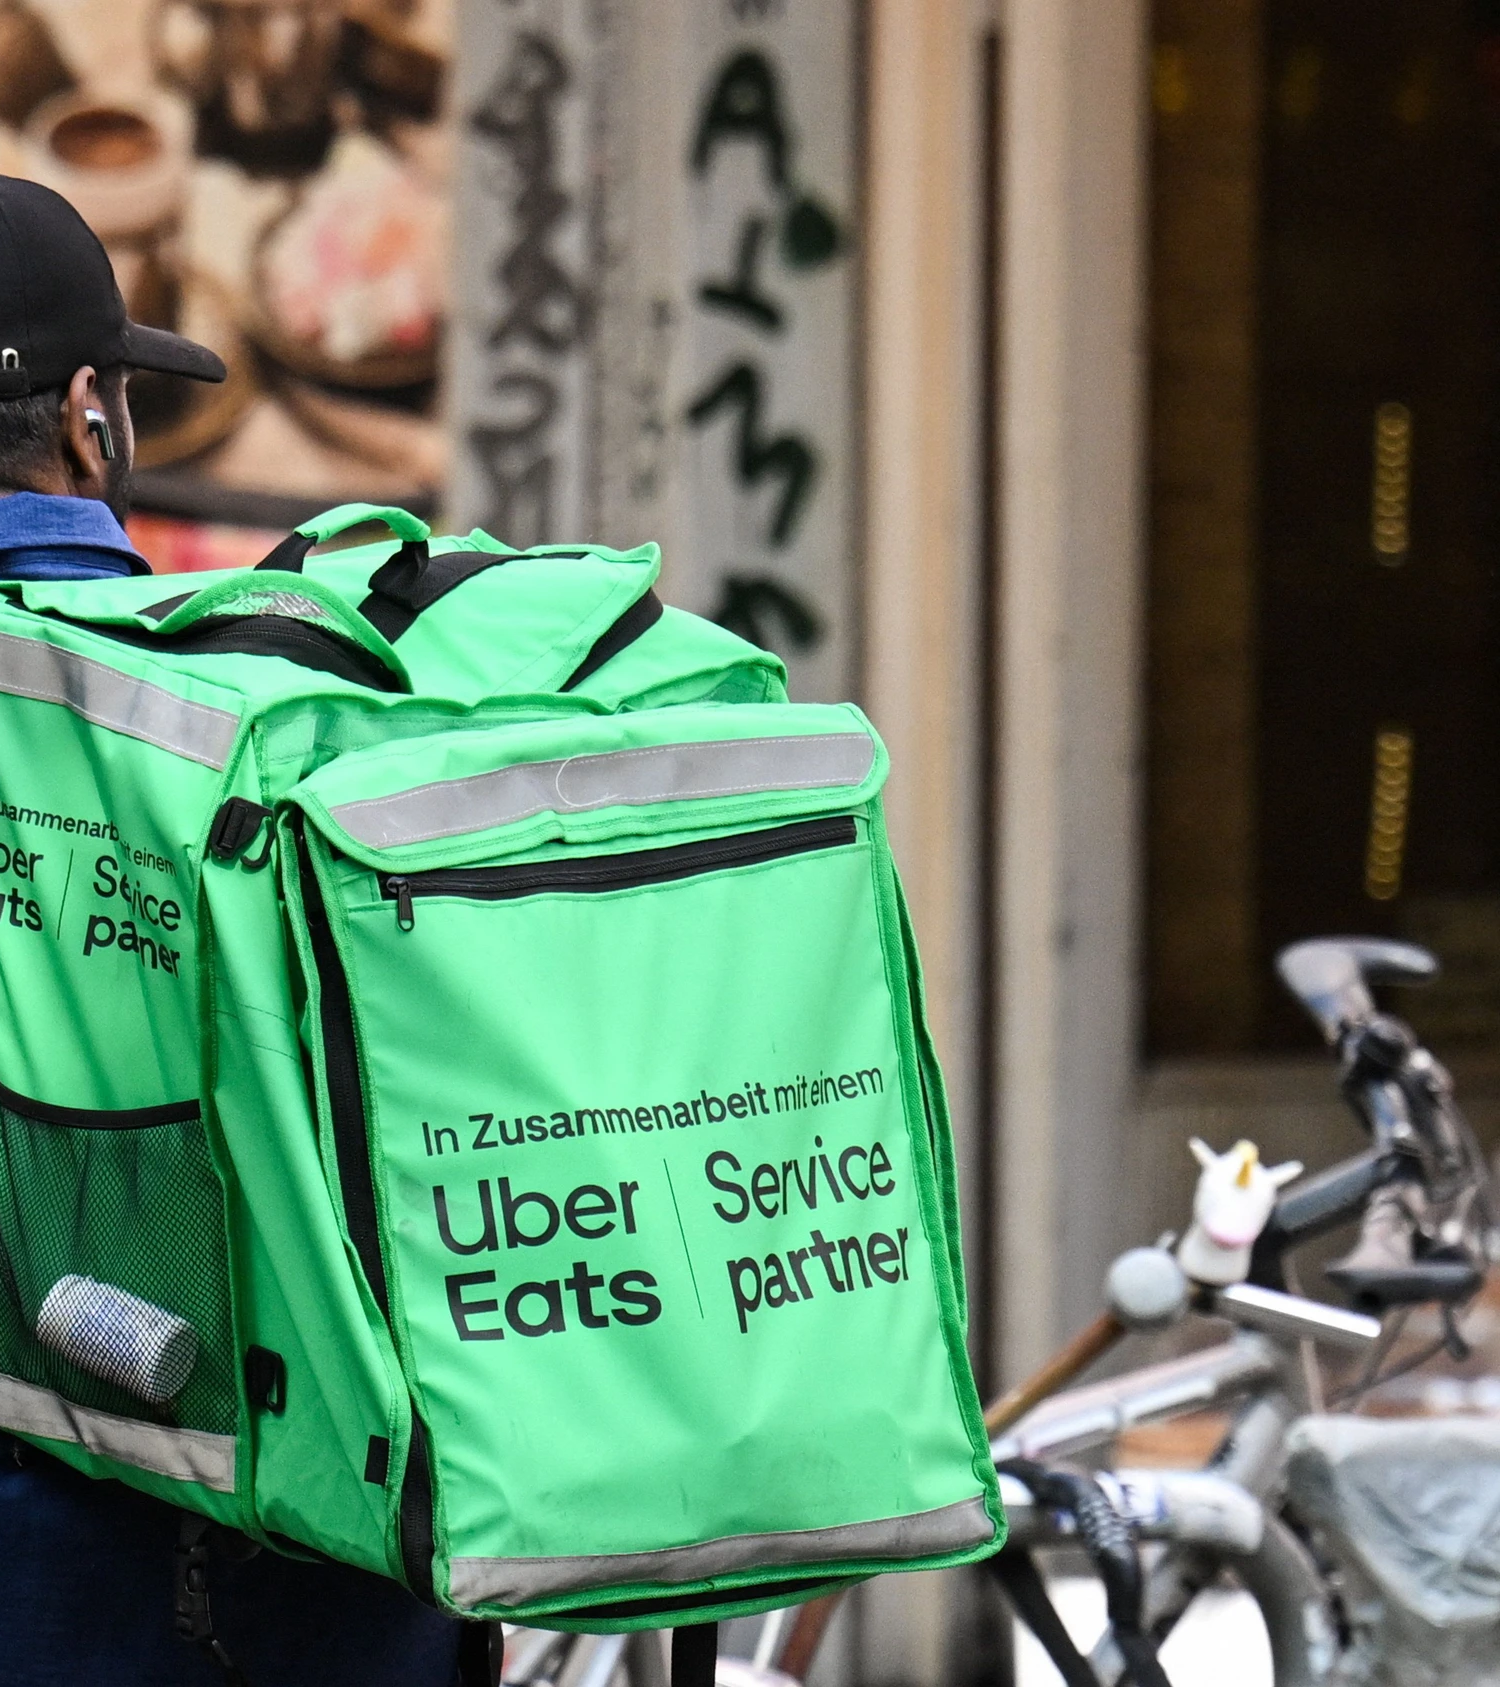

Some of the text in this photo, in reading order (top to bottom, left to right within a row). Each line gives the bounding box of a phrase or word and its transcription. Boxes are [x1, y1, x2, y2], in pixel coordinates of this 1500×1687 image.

[93, 855, 181, 931] Seice
[133, 846, 177, 877] einem
[83, 914, 180, 979] paner
[421, 1067, 884, 1157] In Zusammenarbeit mit einem
[432, 1176, 640, 1256] Uber
[704, 1135, 896, 1223] Service
[444, 1261, 662, 1342] Eats
[726, 1227, 910, 1333] partner
